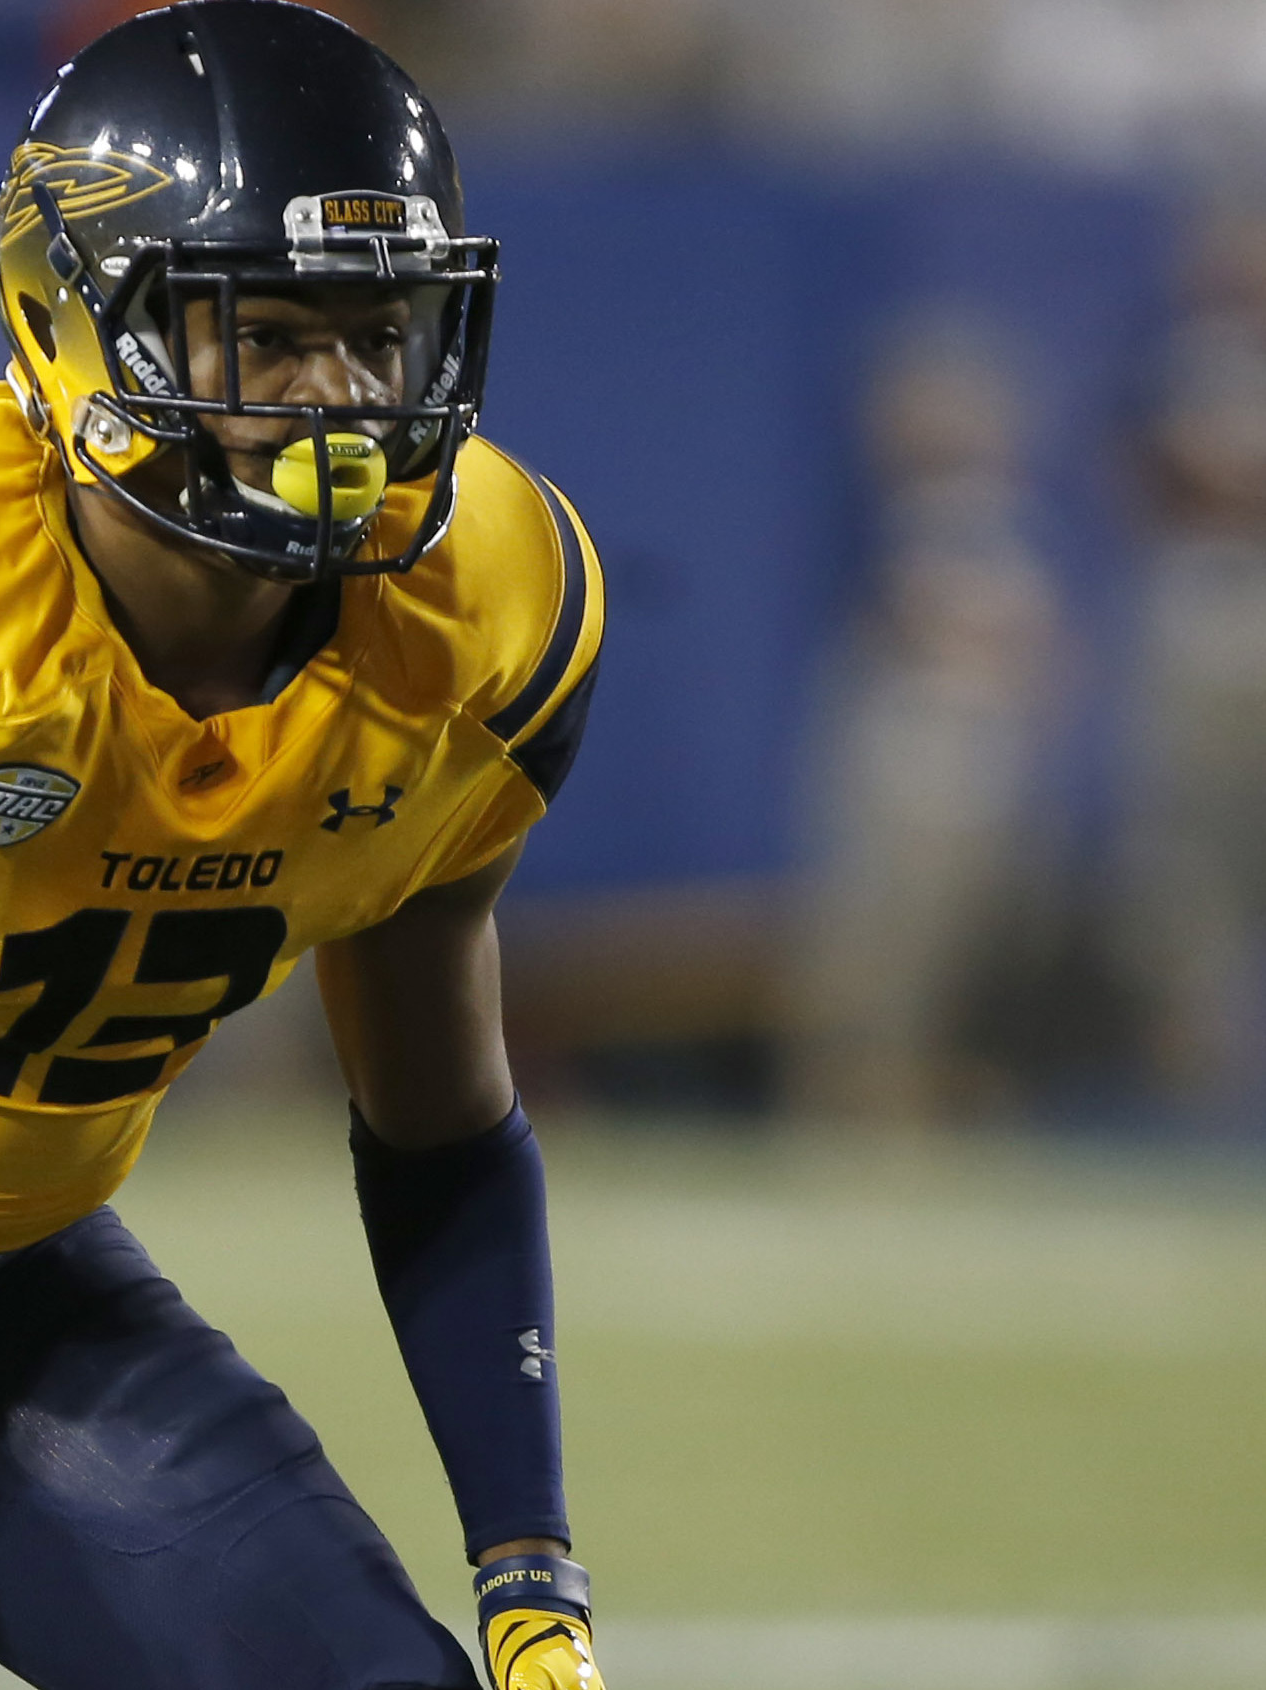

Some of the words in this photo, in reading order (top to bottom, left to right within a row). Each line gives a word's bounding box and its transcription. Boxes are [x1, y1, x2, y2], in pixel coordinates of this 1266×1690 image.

[100, 849, 284, 892] TOLEDO
[480, 1569, 526, 1596] ABOUT
[529, 1569, 552, 1583] US
